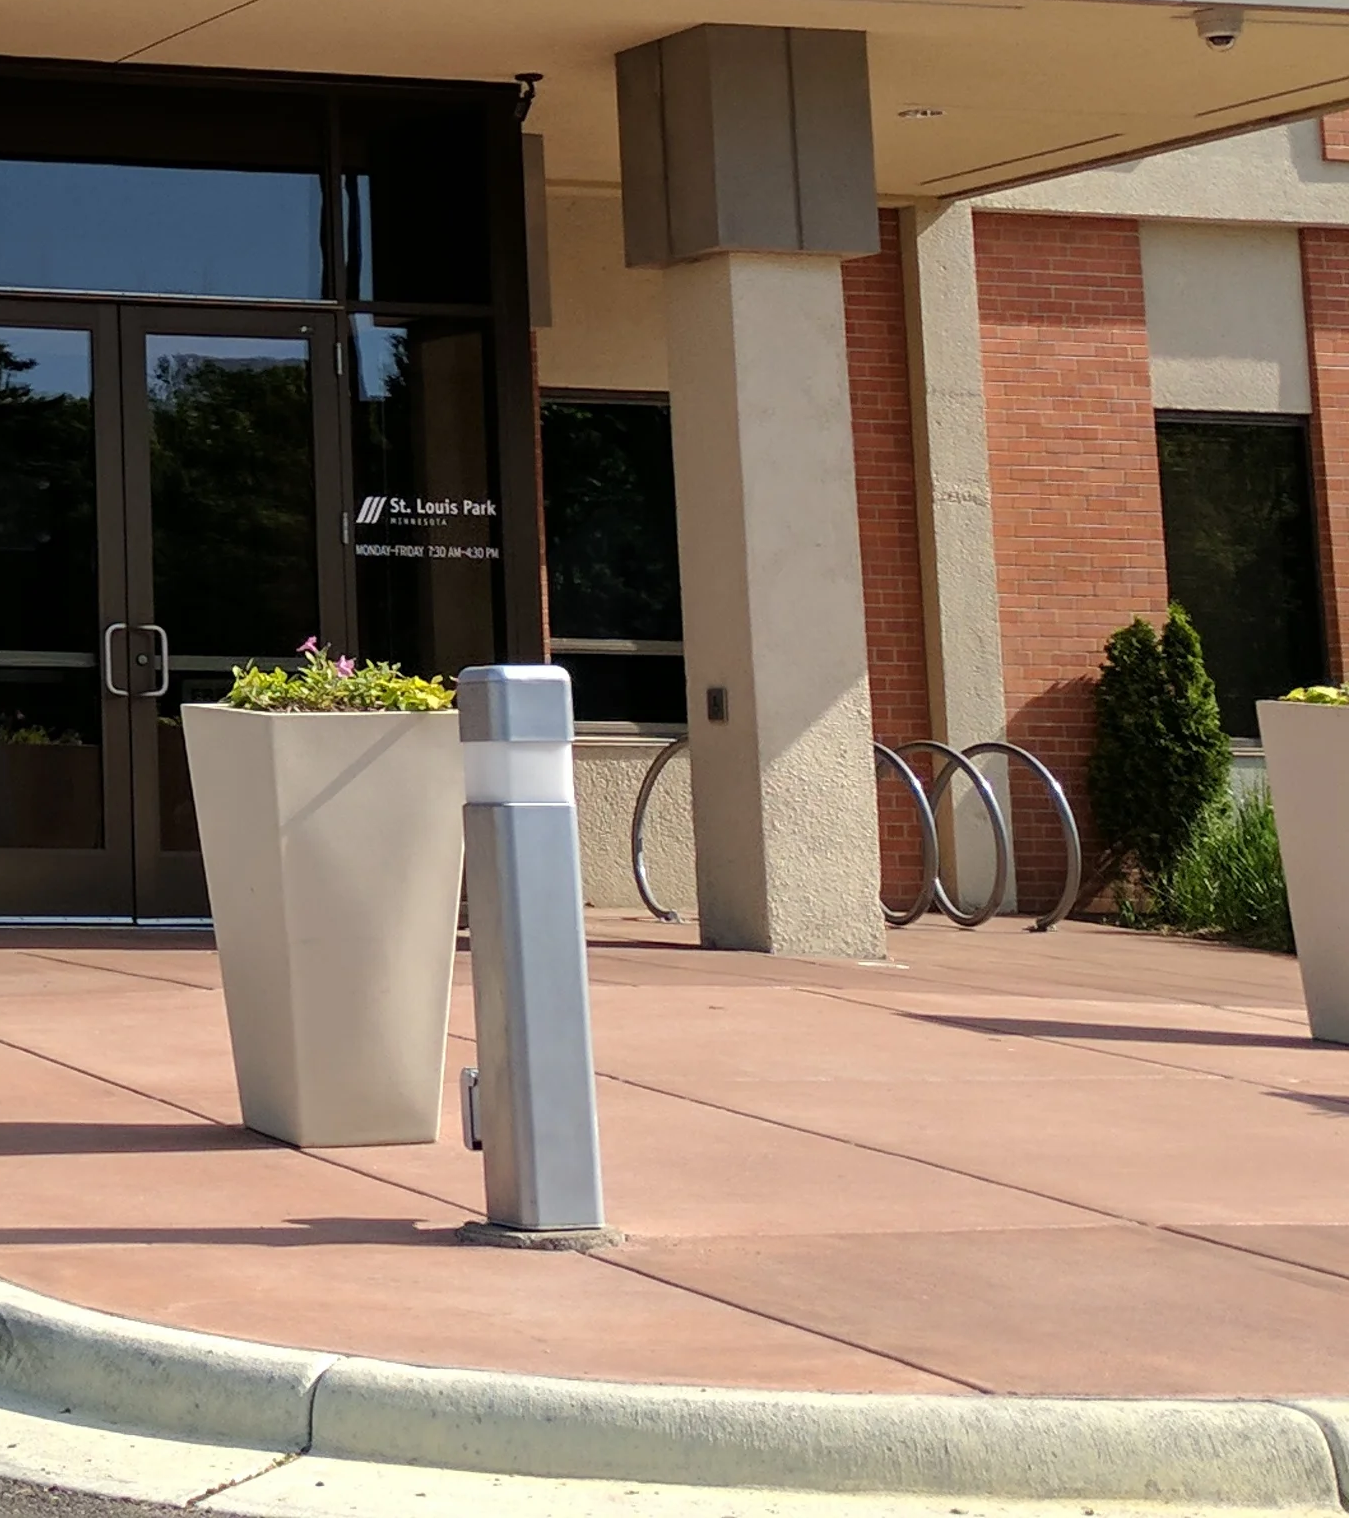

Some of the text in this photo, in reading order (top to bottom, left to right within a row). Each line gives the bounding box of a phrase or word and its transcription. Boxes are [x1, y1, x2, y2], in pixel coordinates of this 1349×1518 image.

[390, 497, 497, 517] St. Louis Park
[390, 517, 448, 526] MINNESOTA
[485, 547, 500, 559] PM
